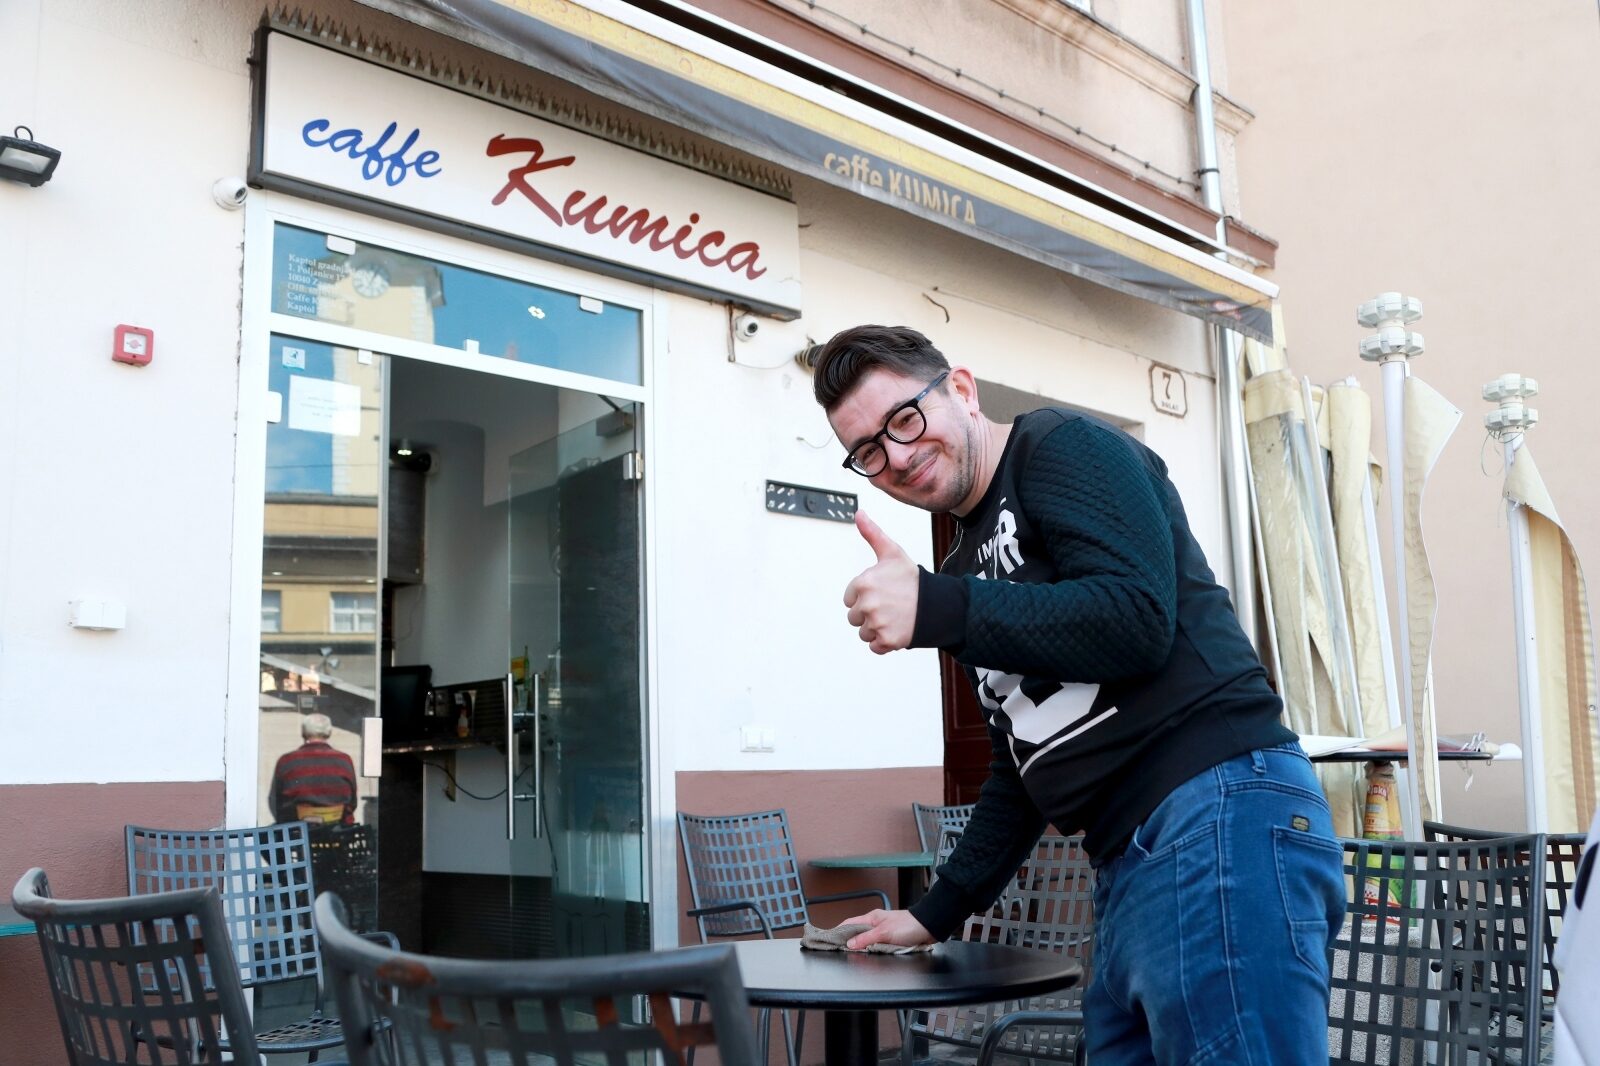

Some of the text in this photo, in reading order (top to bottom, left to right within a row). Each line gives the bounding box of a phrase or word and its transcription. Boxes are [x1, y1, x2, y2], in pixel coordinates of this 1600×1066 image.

[302, 119, 442, 187] caffe
[823, 152, 883, 187] caffe
[486, 133, 768, 280] Kumica
[288, 253, 317, 267] Kaptol
[287, 291, 311, 303] Caffe
[287, 301, 316, 314] Kaptol
[1162, 371, 1171, 399] 7
